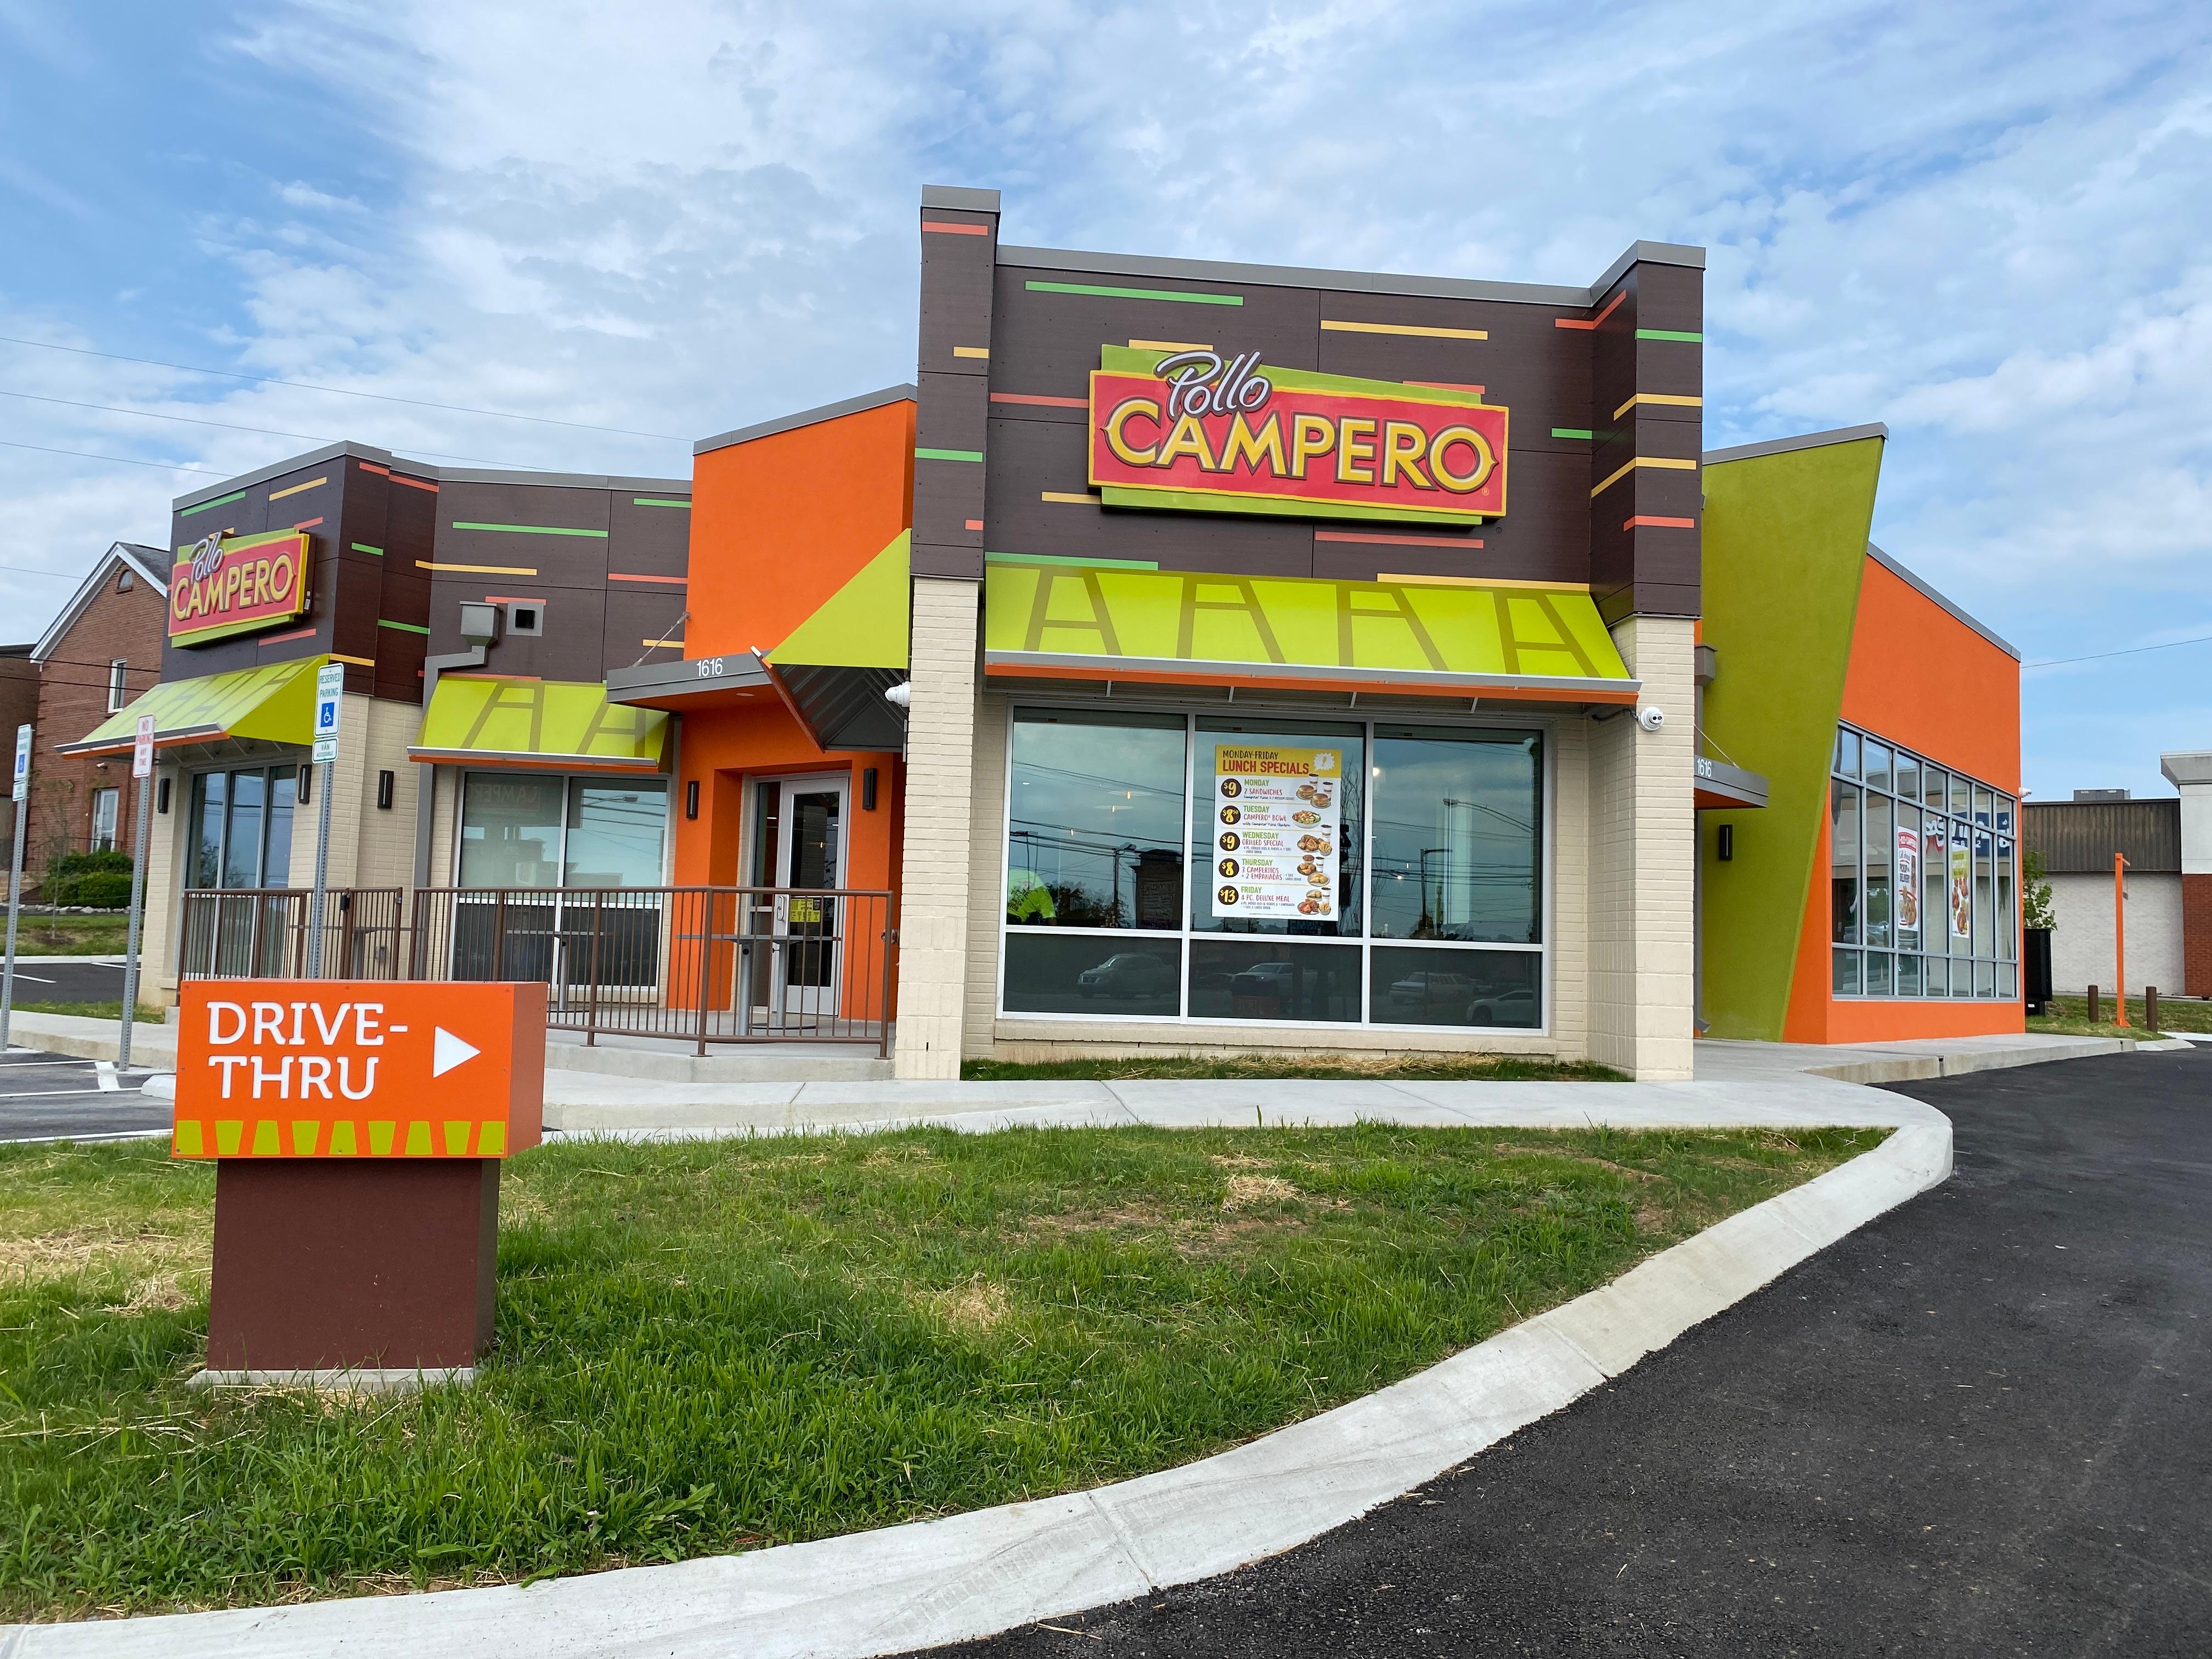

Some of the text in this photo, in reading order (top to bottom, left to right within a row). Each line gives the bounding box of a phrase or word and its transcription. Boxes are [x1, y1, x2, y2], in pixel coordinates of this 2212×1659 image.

[1155, 350, 1270, 418] Pollo
[1101, 396, 1498, 492] CAMPERO
[190, 531, 223, 584] Pollo
[173, 553, 297, 621] CAMPERO
[696, 657, 723, 677] 1616
[319, 673, 341, 684] RESERVED
[320, 687, 338, 698] PARKING
[1223, 750, 1278, 759] MONDAY-FRIDAY
[1222, 760, 1309, 774] LUNCH SPECIALS
[1697, 758, 1712, 777] 1616
[1223, 782, 1237, 795] $9
[1222, 835, 1235, 849] $9
[1222, 861, 1234, 876] $8
[1220, 889, 1235, 902] $13
[206, 1001, 408, 1046] DRIVE-
[208, 1055, 380, 1101] THRU
